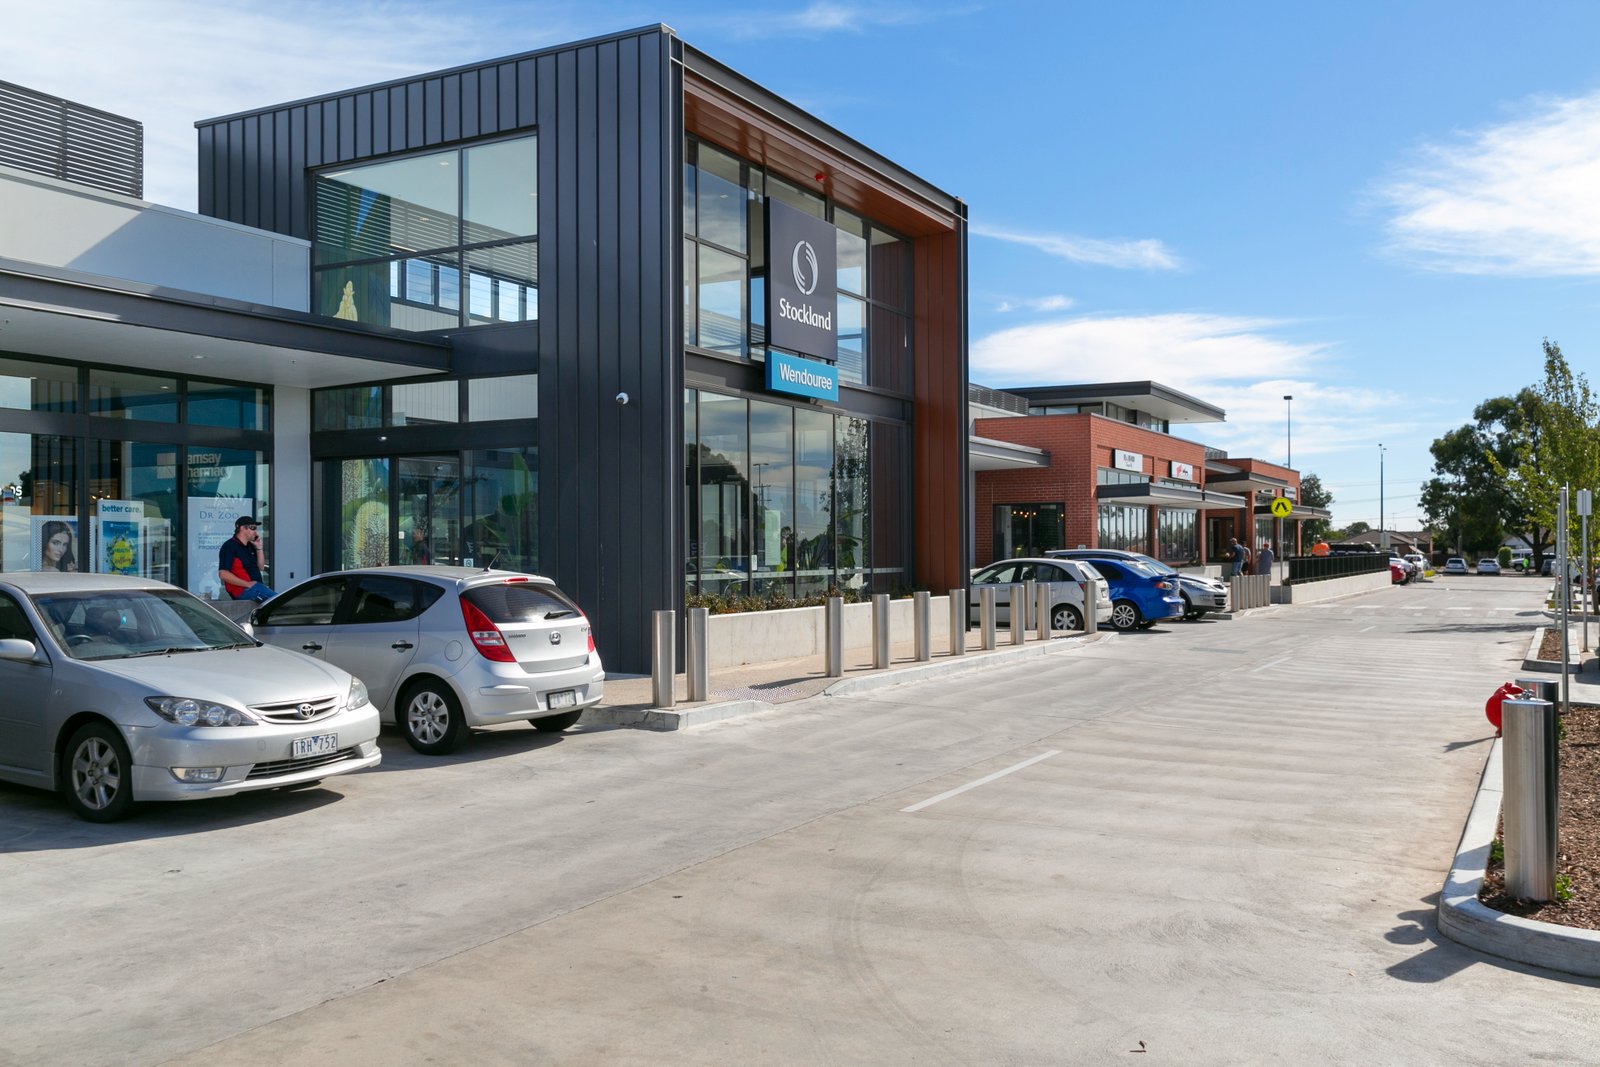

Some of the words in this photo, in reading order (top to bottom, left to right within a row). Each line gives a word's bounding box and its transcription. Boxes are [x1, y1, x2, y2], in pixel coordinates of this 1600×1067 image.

[779, 297, 832, 331] Stockland
[779, 363, 833, 390] Wendouree
[187, 453, 222, 466] amsay
[187, 464, 233, 480] harmacy
[102, 504, 123, 513] better
